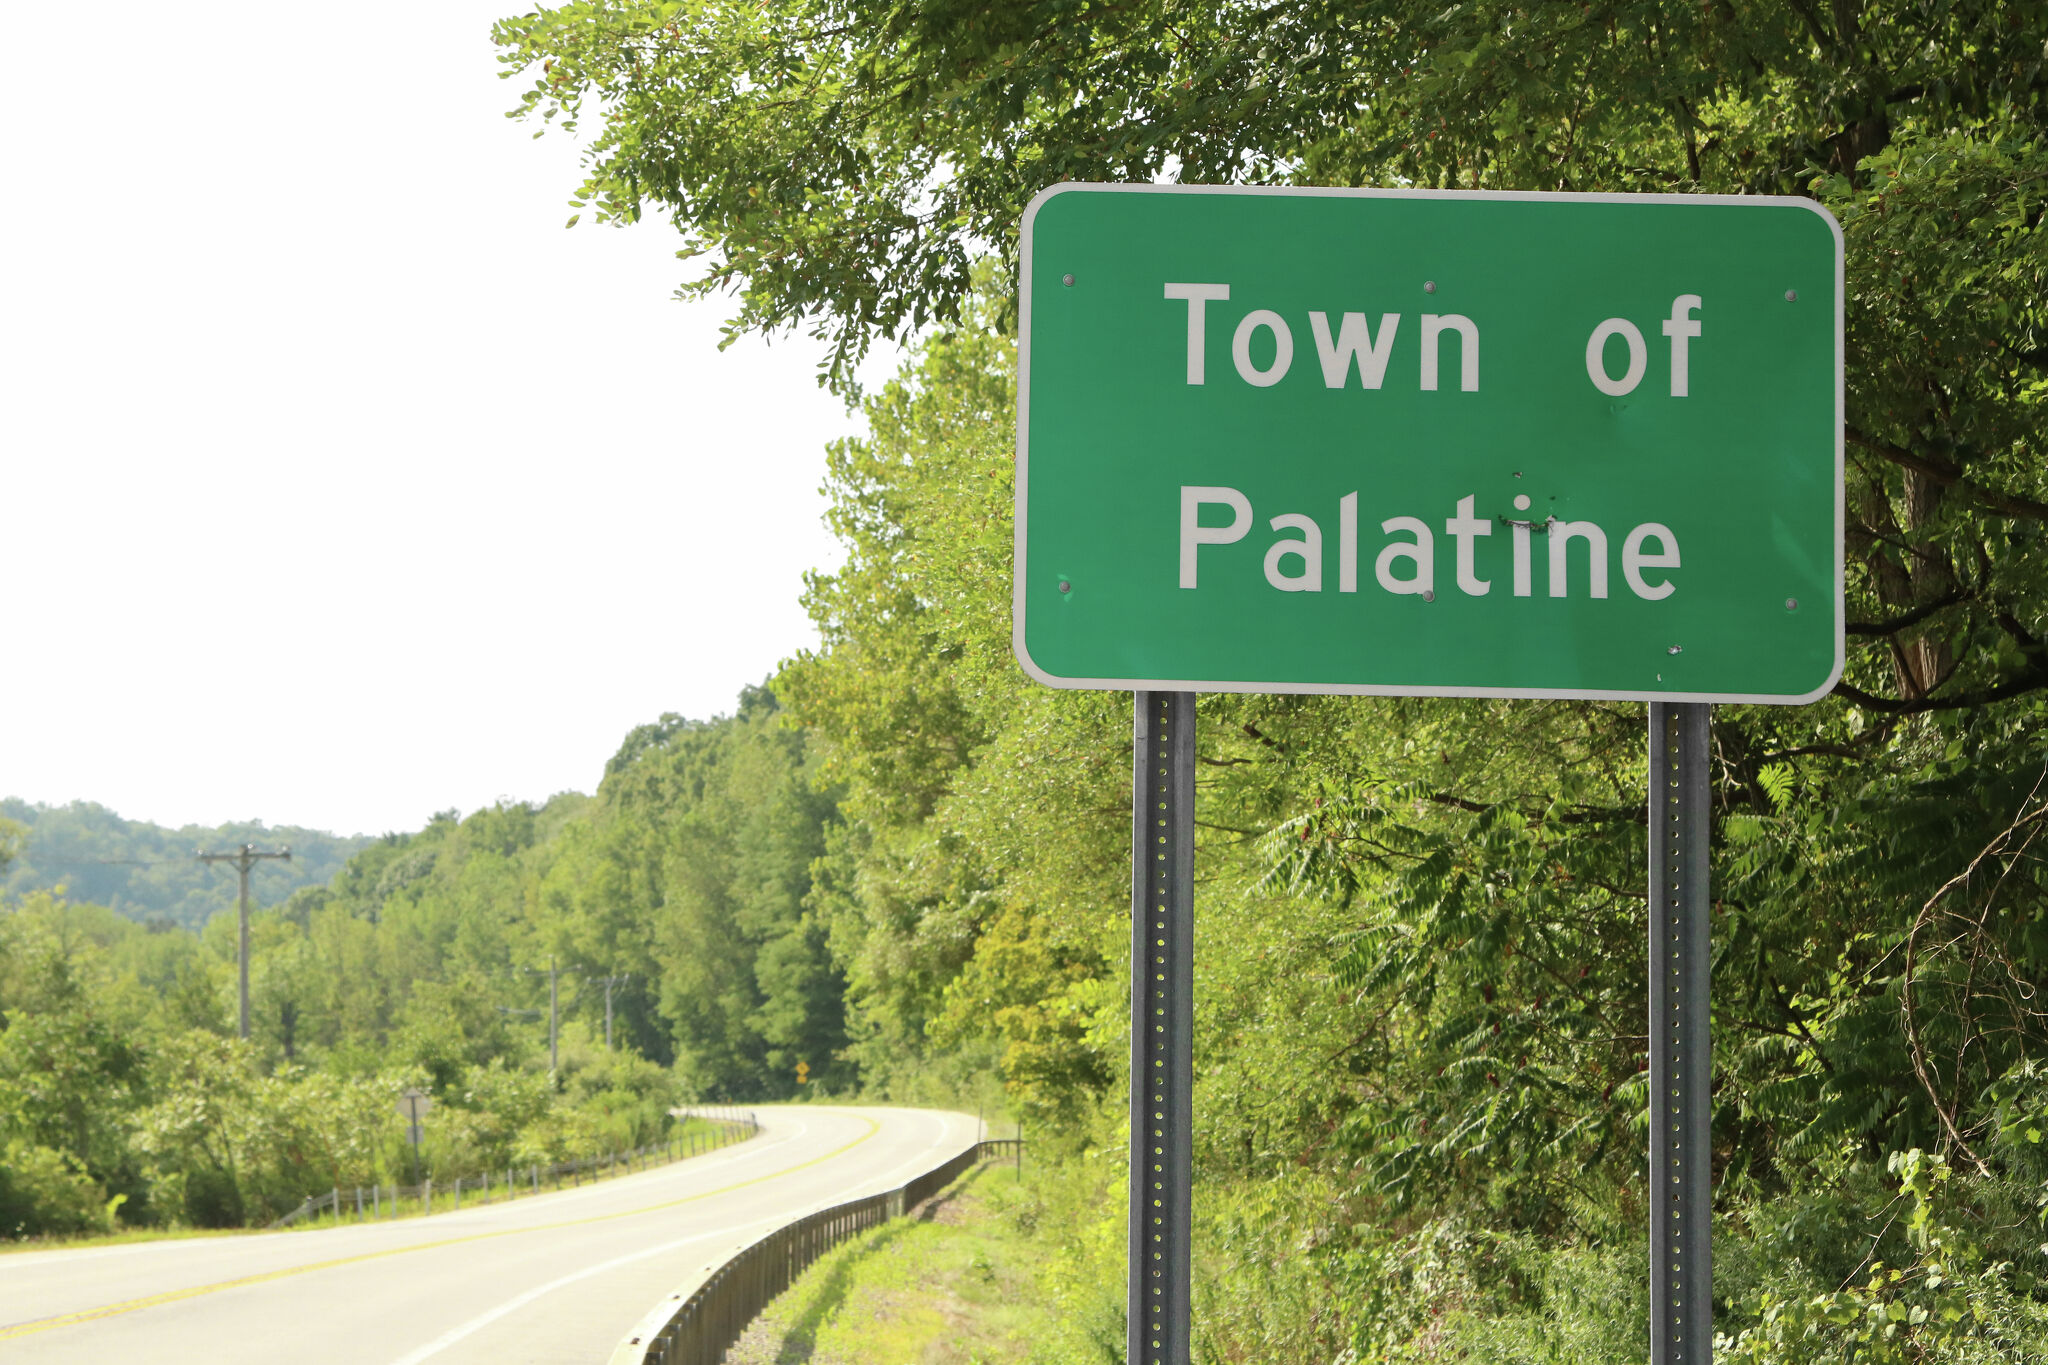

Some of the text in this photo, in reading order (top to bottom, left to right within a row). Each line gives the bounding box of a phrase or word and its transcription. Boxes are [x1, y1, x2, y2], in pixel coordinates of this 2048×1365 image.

[1164, 282, 1702, 397] Town of
[1179, 485, 1681, 601] Palatine
